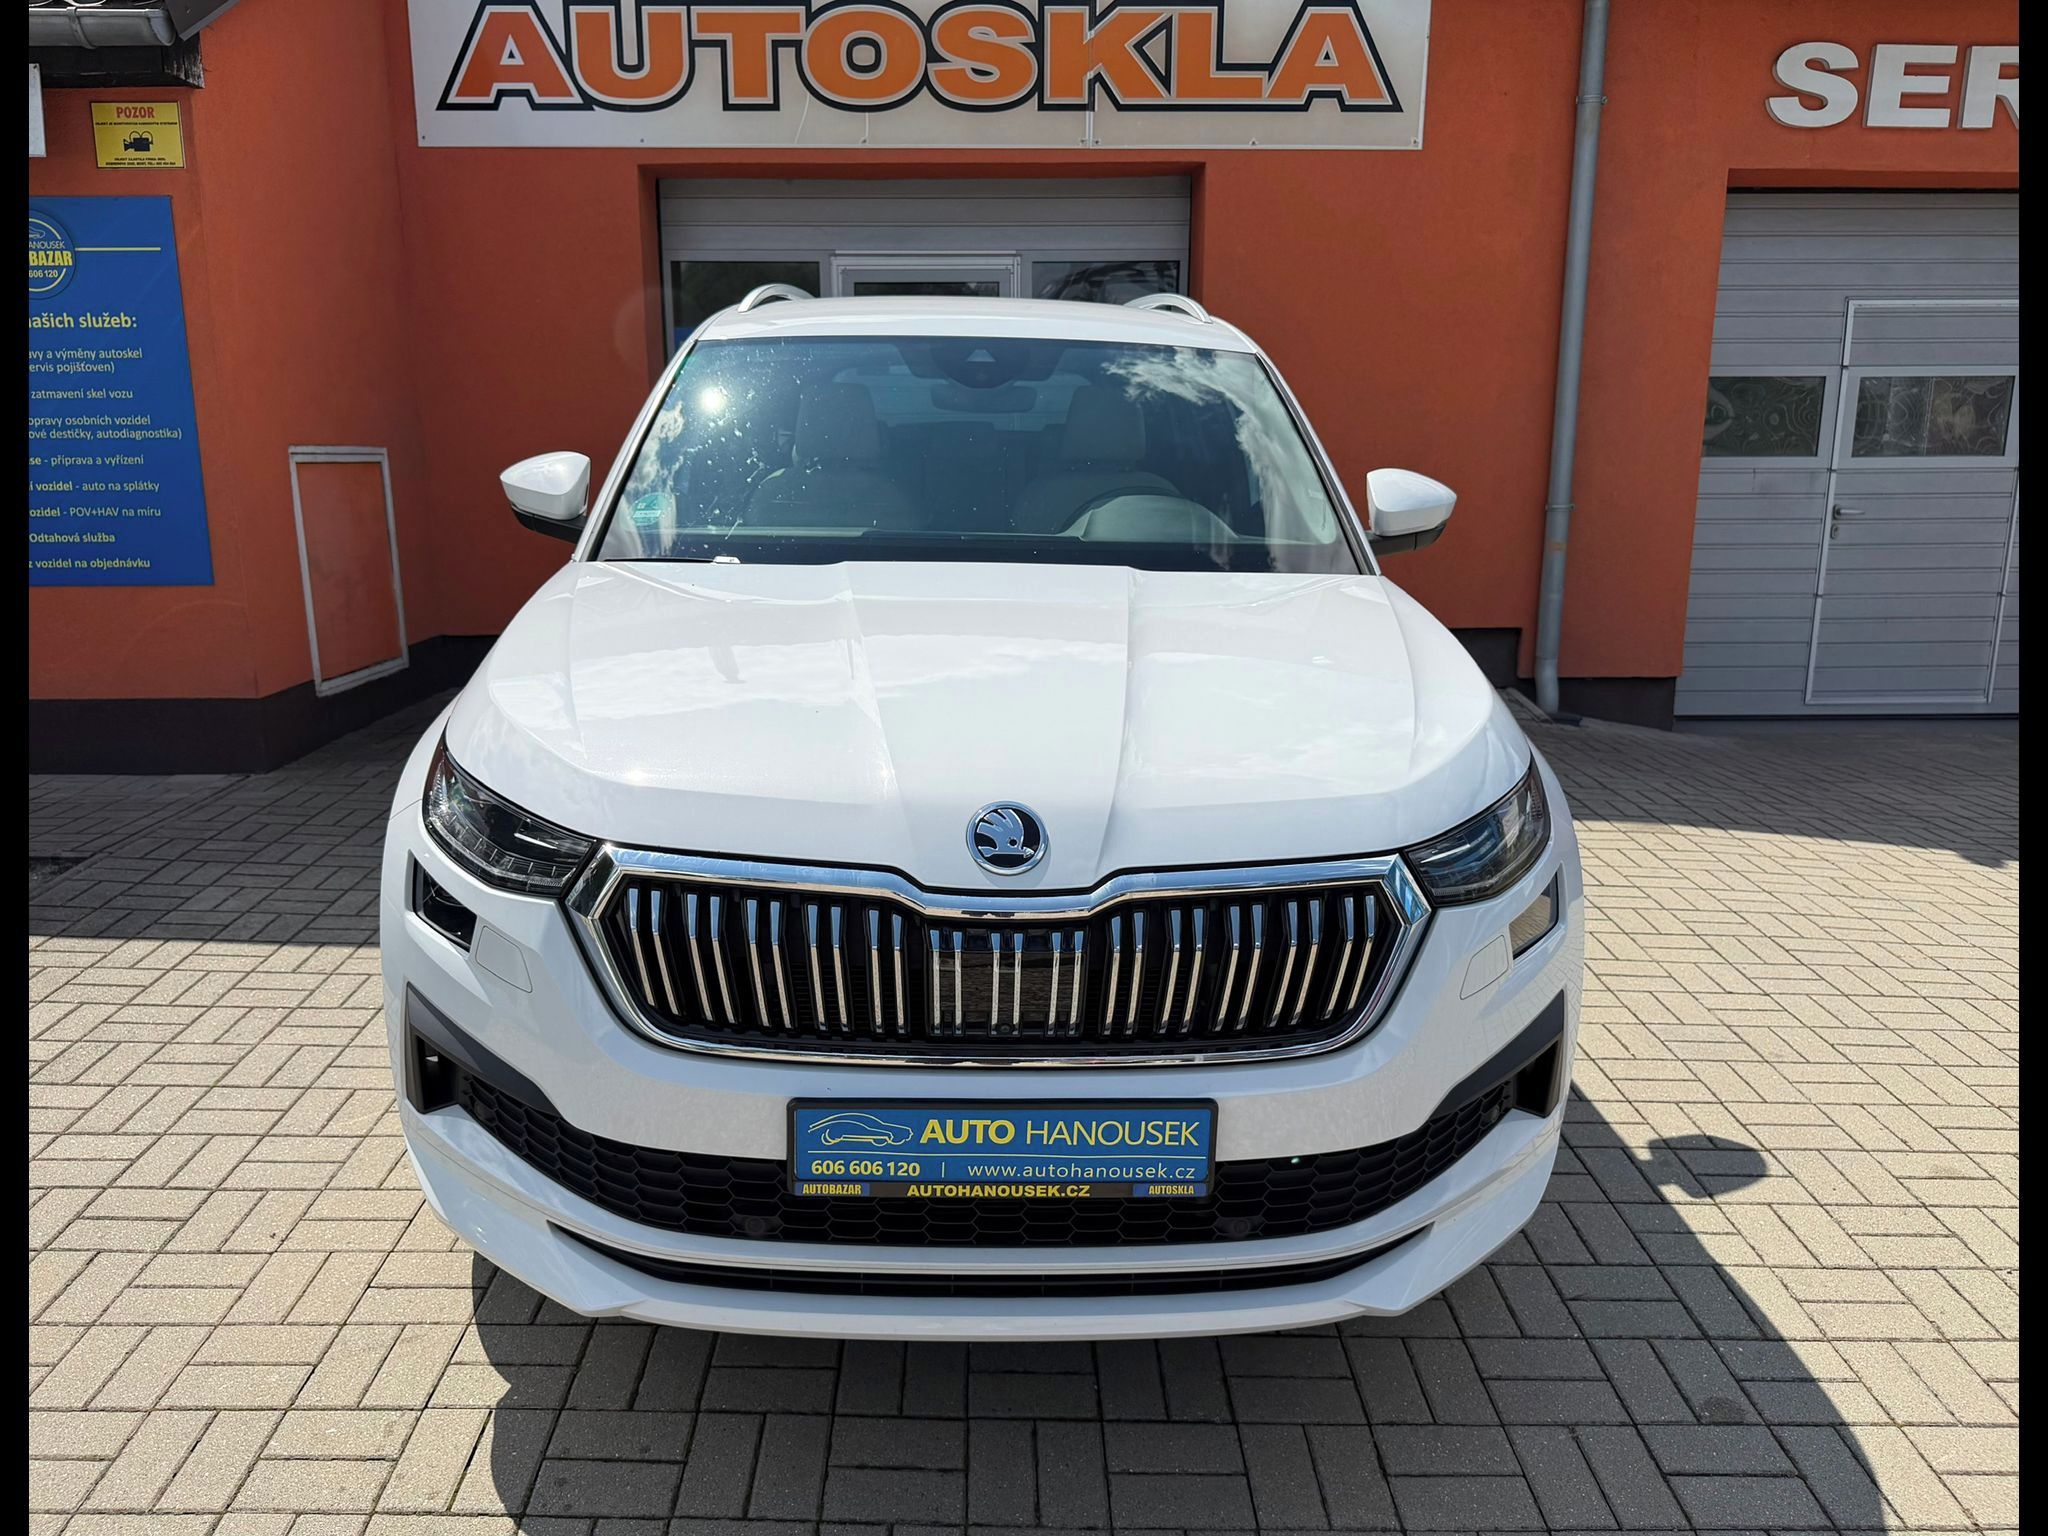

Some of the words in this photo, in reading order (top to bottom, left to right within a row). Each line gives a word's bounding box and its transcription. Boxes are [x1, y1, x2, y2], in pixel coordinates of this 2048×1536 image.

[436, 0, 1403, 112] AUTOSKLA
[1766, 41, 2019, 129] SER
[116, 106, 155, 118] POZOR
[29, 251, 73, 266] BAZAR
[44, 270, 59, 278] 120
[79, 312, 138, 328] služeb:
[46, 351, 53, 359] a
[55, 348, 96, 361] výměny
[99, 348, 143, 359] autoskel
[57, 361, 115, 374] pojišťoven)
[31, 389, 84, 399] zatmavení
[87, 389, 106, 399] skel
[109, 390, 133, 399] vozu
[65, 415, 112, 425] osobních
[115, 415, 151, 425] vozidel
[49, 428, 94, 440] destičky,
[97, 427, 182, 440] autodiagnostika)
[51, 455, 92, 467] příprava
[96, 457, 102, 465] a
[104, 454, 144, 467] vyřízení
[36, 481, 73, 491] vozidel
[82, 482, 106, 491] auto
[108, 482, 121, 491] na
[123, 481, 160, 493] splátky
[70, 507, 119, 517] POV+HAV
[122, 508, 135, 517] na
[137, 506, 161, 517] míru
[29, 532, 80, 543] Odtahová
[82, 532, 115, 543] služba
[36, 558, 72, 568] vozidel
[75, 560, 88, 568] na
[90, 558, 150, 570] objednávku
[920, 1119, 1016, 1144] AUTO
[1026, 1120, 1200, 1147] HANOUSEK
[811, 1161, 846, 1175] 606
[849, 1161, 883, 1176] 606
[886, 1162, 920, 1177] 120
[967, 1162, 1196, 1180] www.autohanousek.cz
[802, 1184, 862, 1195] AUTOBAZAR
[906, 1185, 1091, 1198] AUTOHANOUSEK.CZ
[1148, 1185, 1195, 1196] AUTOSKLA
